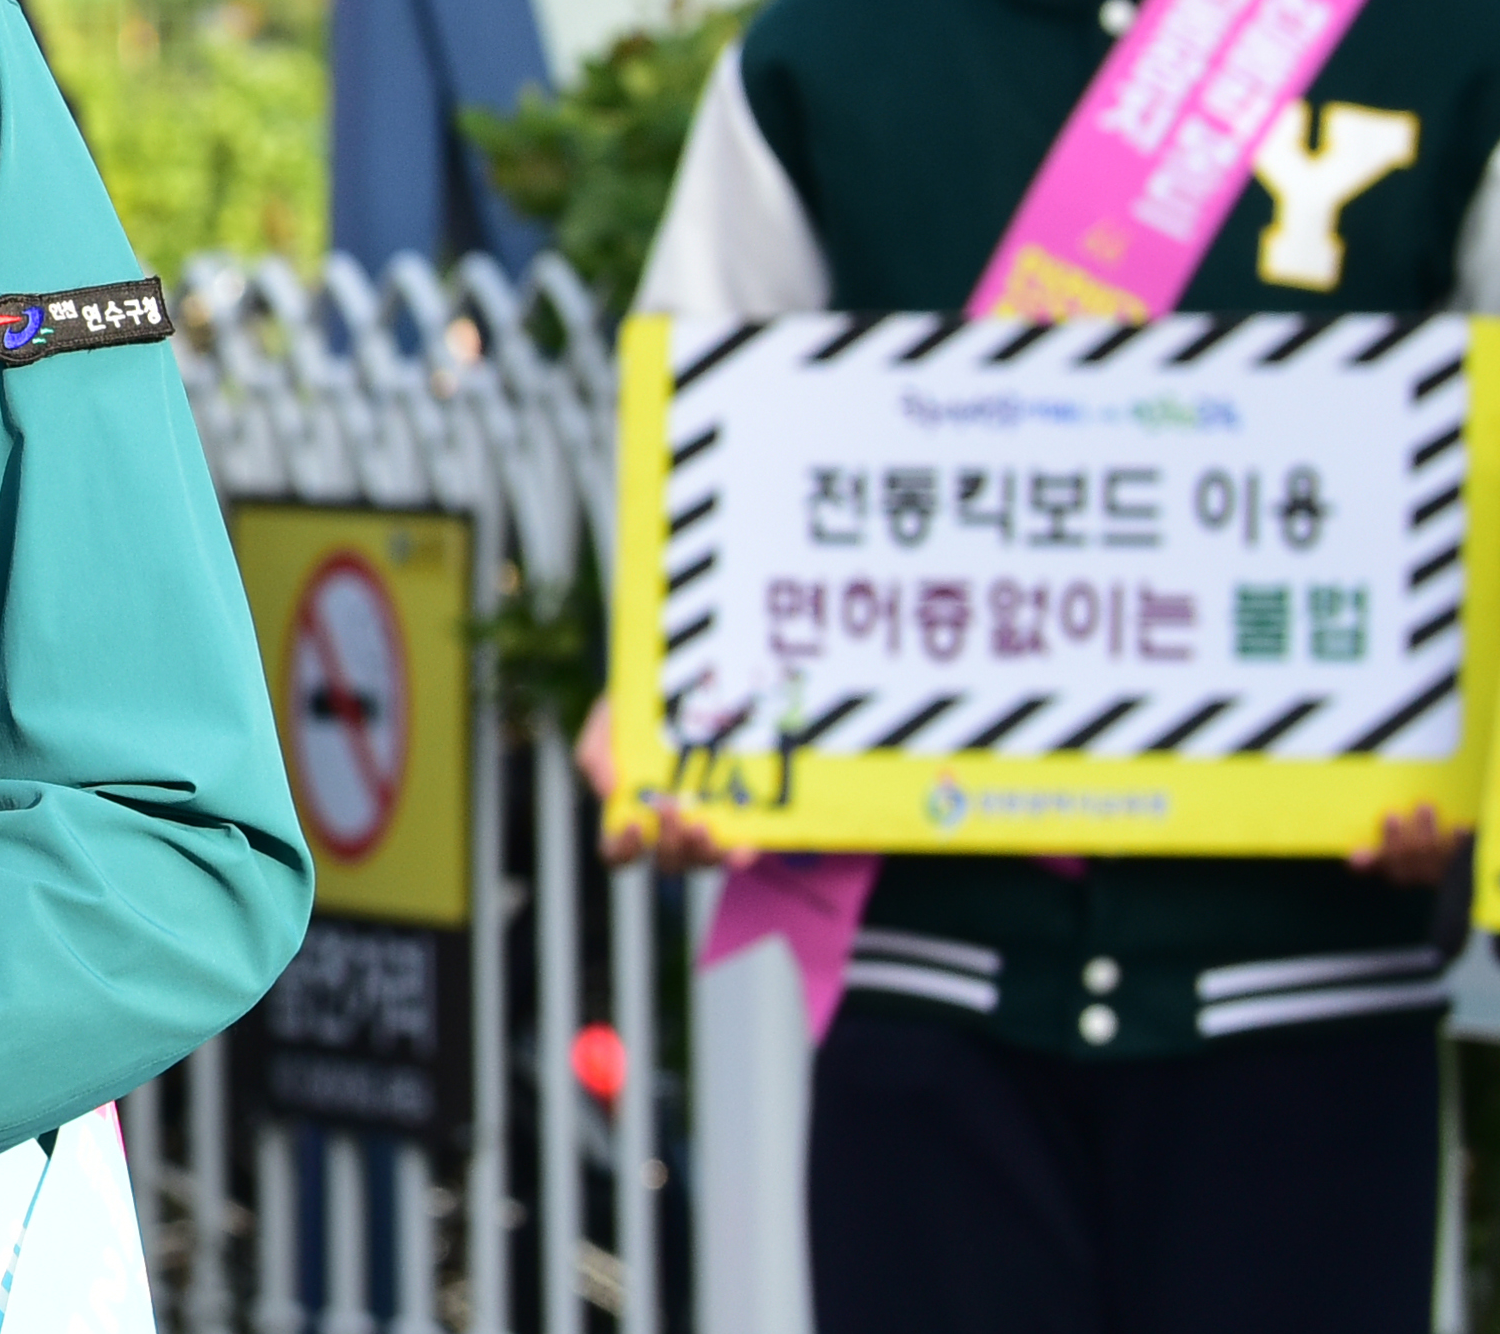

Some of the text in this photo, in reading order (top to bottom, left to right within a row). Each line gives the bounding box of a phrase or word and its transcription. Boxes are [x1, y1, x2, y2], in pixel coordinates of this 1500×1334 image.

[1257, 101, 1420, 292] Y
[81, 295, 163, 333] 연수구청
[809, 466, 1331, 551] 전동킥보드 이용
[766, 579, 1369, 662] 면허증없이는 불법
